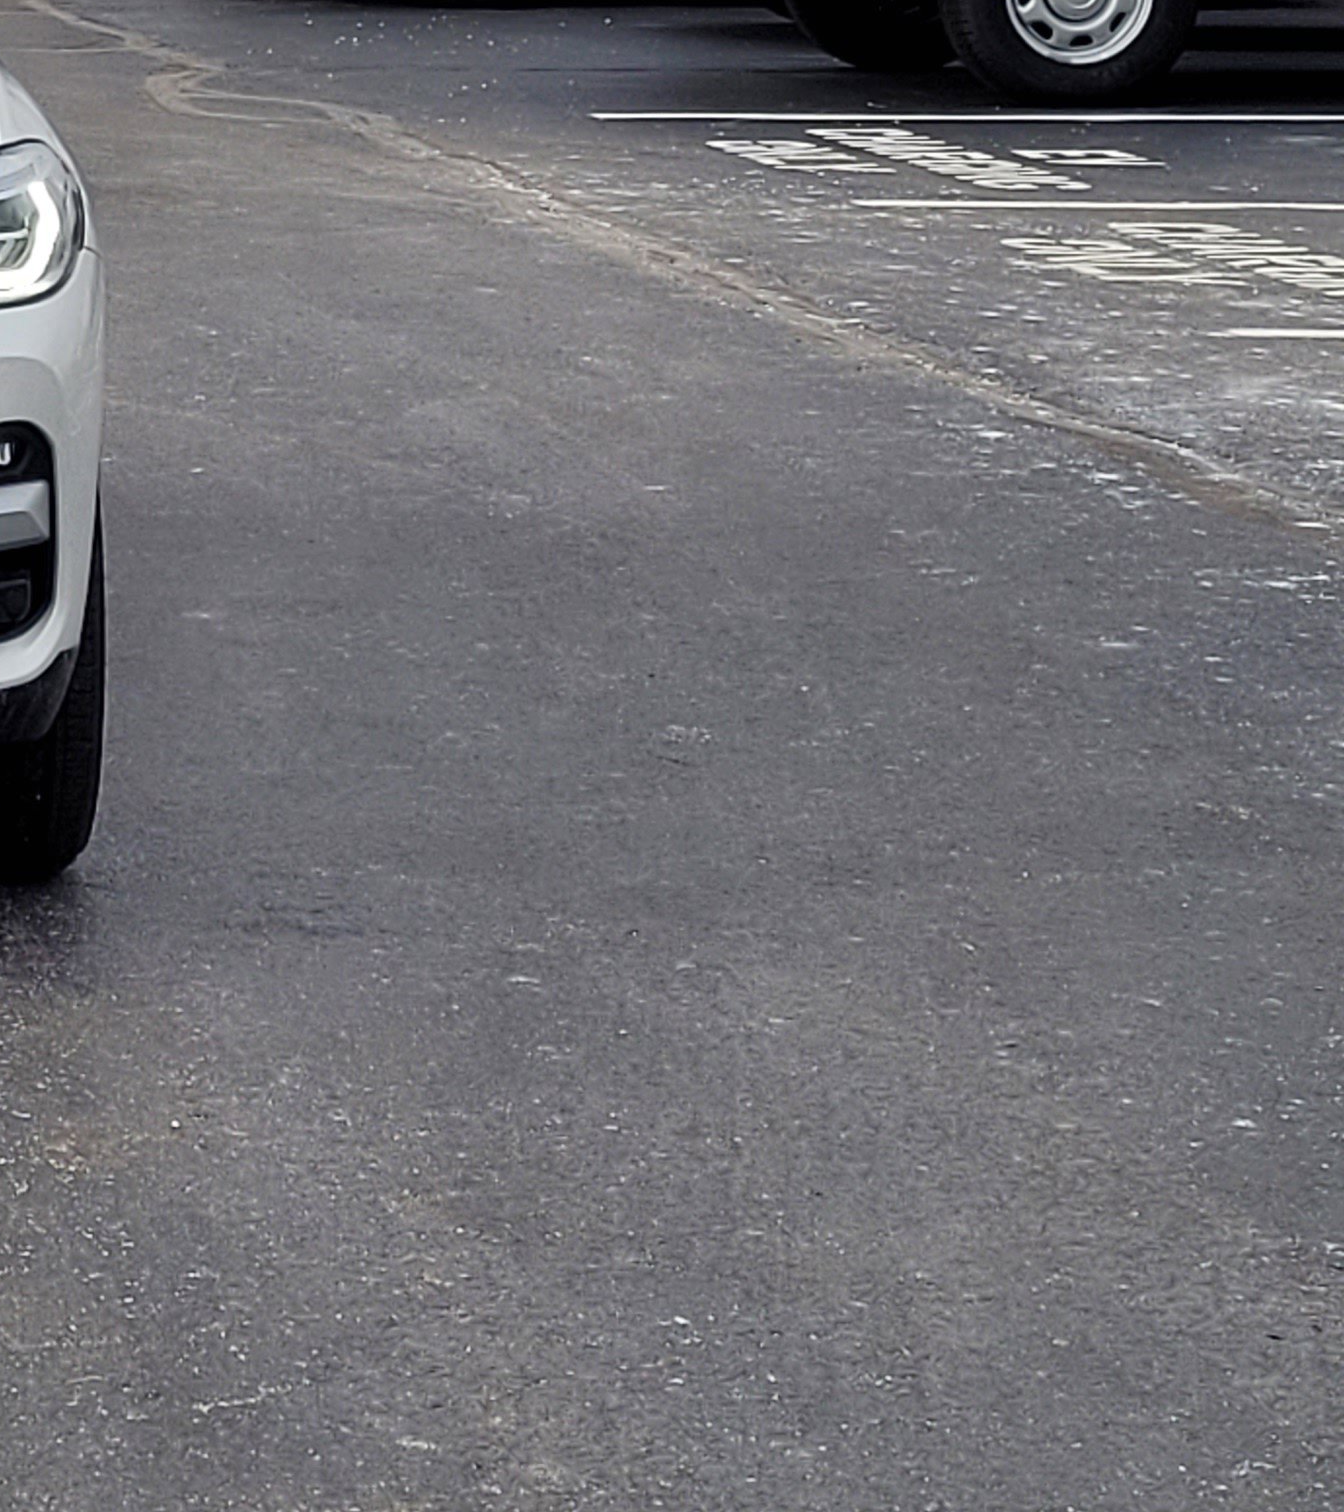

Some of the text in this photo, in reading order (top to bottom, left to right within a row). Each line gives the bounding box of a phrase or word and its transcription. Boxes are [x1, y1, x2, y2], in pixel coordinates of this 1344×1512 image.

[705, 140, 897, 173] ONLY
[805, 128, 1092, 190] CHARGING
[1010, 149, 1166, 166] EV
